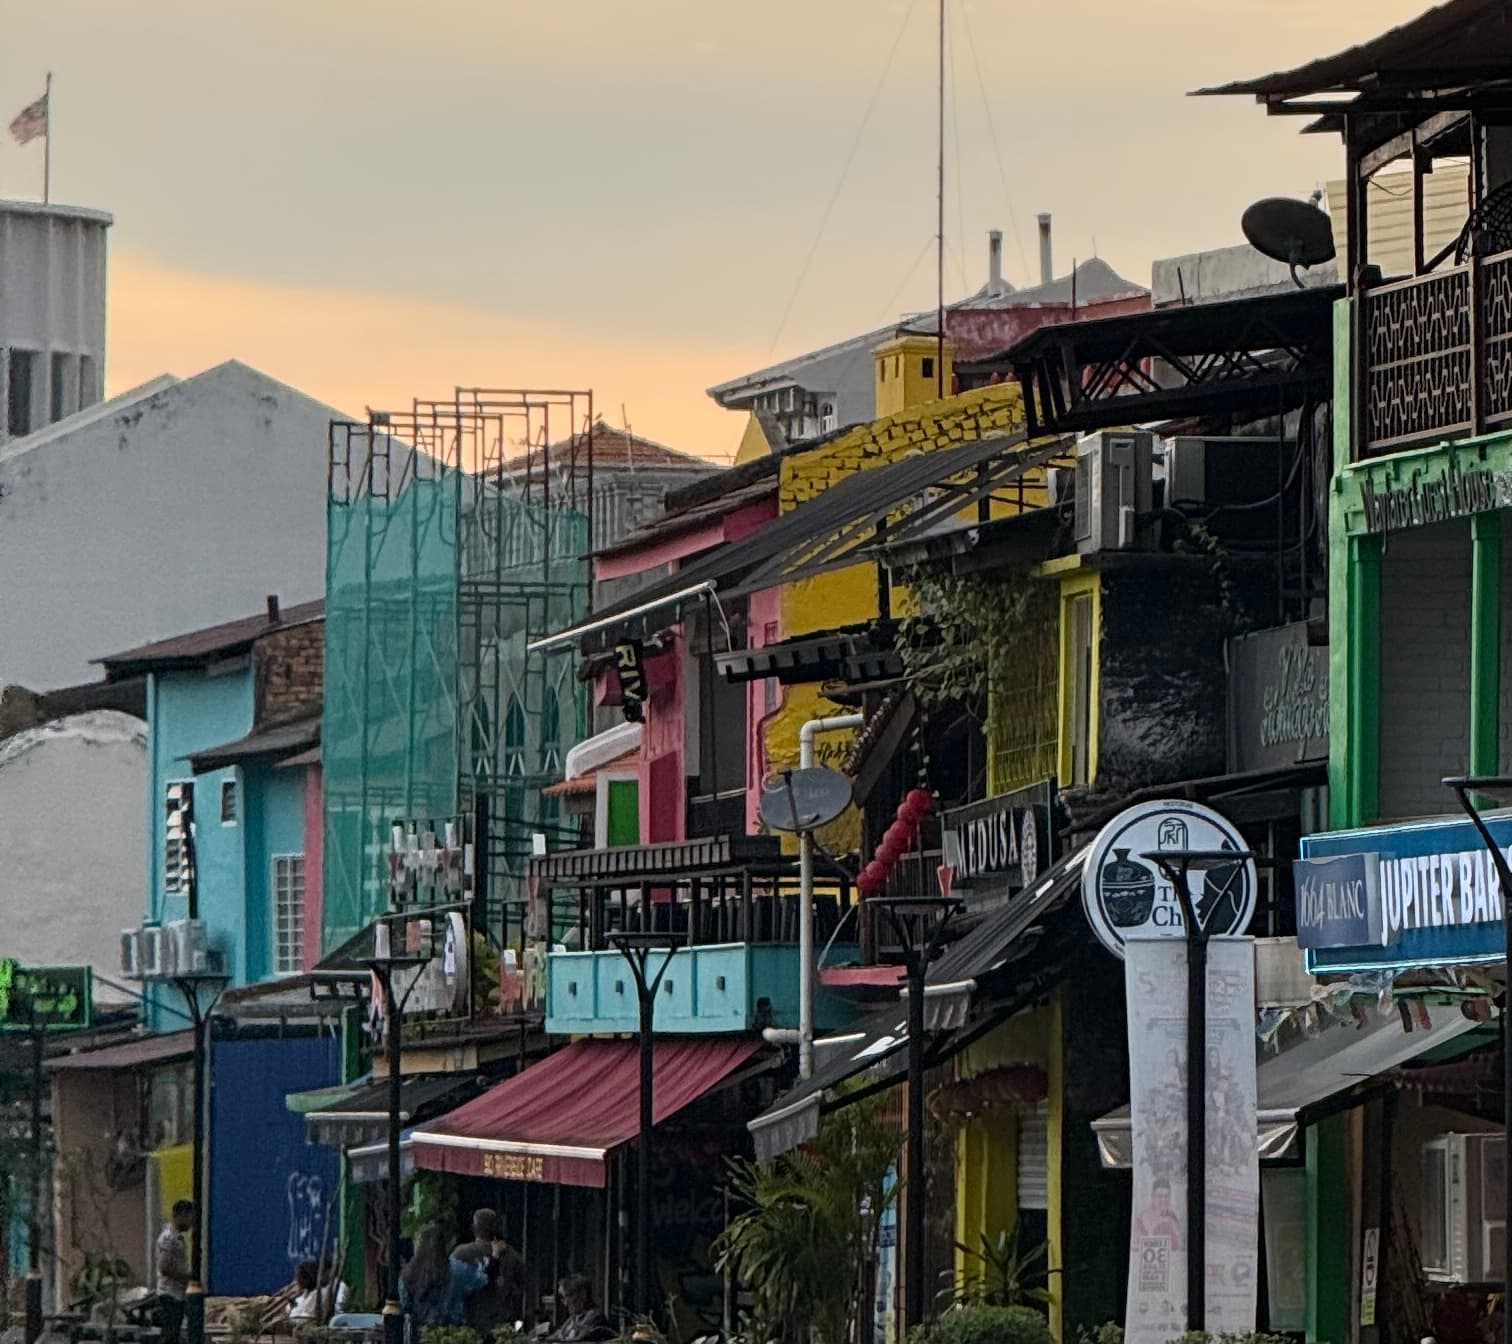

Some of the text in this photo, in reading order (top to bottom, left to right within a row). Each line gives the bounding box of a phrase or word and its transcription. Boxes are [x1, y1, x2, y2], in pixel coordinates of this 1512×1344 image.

[956, 806, 1019, 880] MEDUSA
[1300, 875, 1365, 930] 1664 BLANC
[1380, 852, 1454, 947] JUPITER
[1460, 848, 1503, 922] BAR
